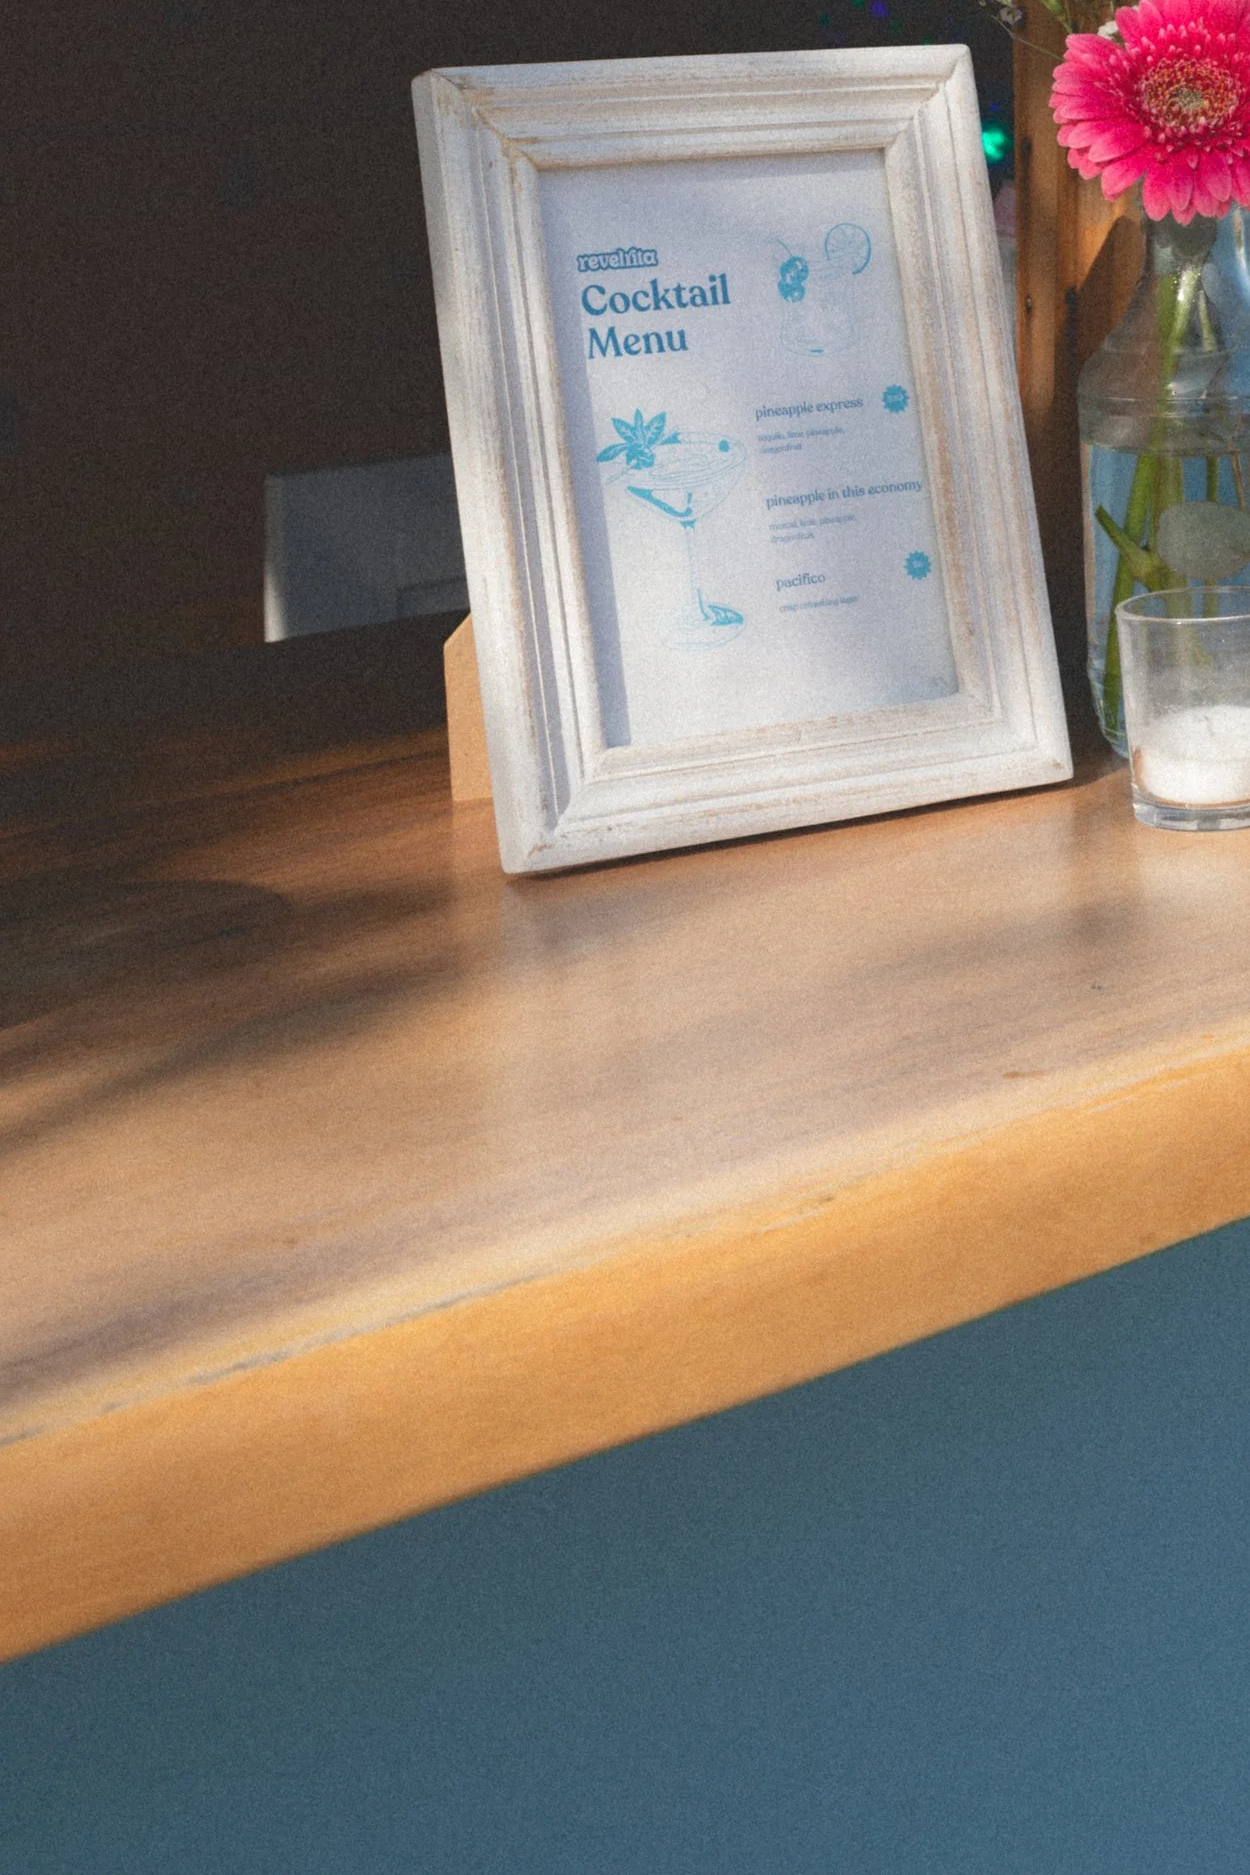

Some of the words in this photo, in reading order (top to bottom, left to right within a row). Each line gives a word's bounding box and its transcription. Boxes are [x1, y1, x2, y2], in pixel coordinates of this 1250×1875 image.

[581, 273, 731, 316] Cocktail
[588, 326, 688, 359] Menu
[755, 401, 813, 421] pineapple
[816, 398, 864, 413] express
[765, 489, 824, 510] pineapple
[828, 488, 840, 500] in
[842, 485, 865, 498] this
[868, 480, 923, 495] economy
[776, 572, 826, 592] pacifico
